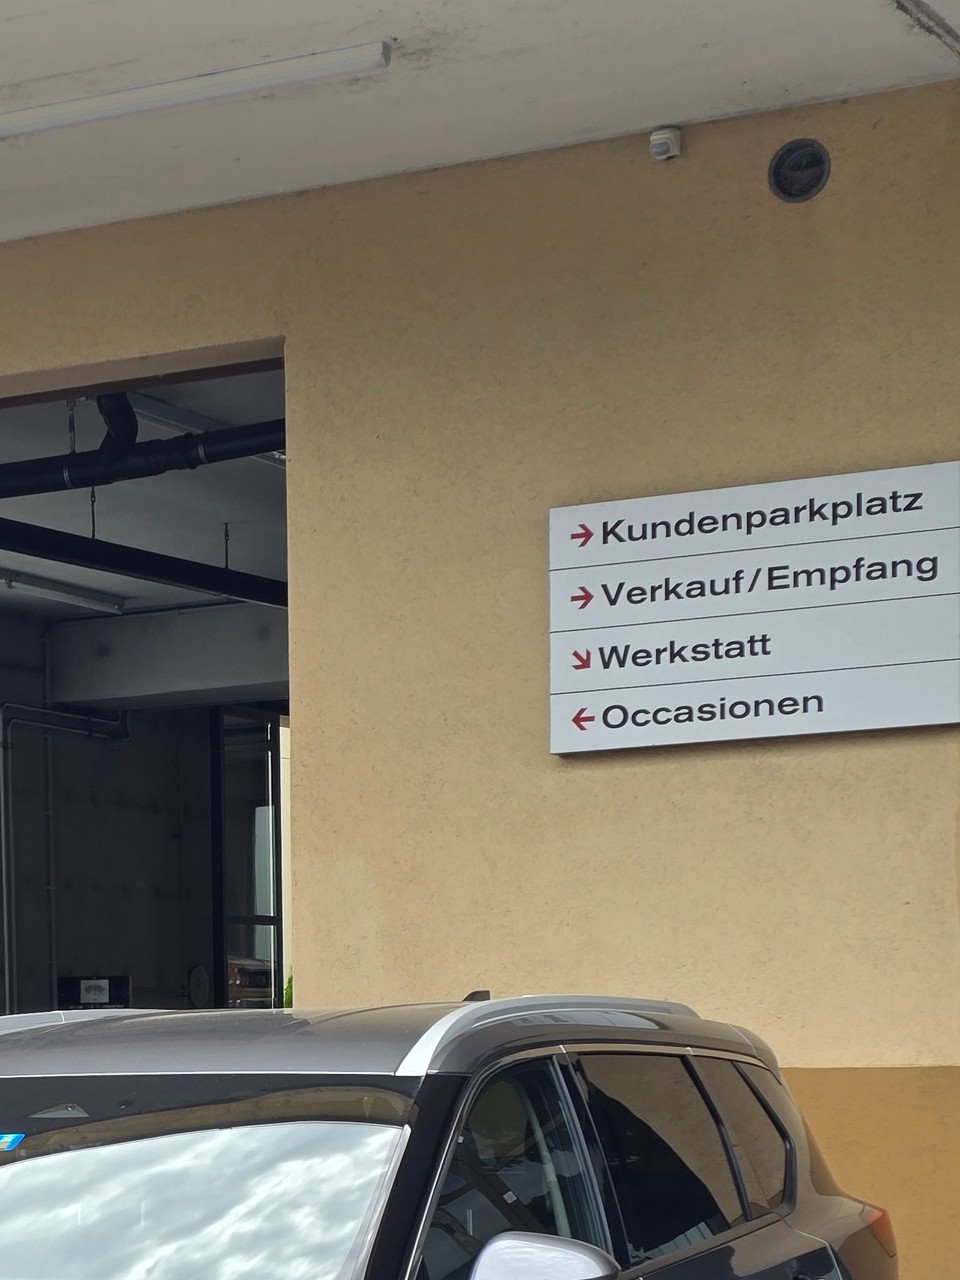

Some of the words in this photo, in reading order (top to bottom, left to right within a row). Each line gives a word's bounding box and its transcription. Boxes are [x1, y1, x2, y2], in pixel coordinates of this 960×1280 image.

[601, 490, 924, 545] Kundenparkplatz
[601, 554, 939, 606] Verkauf/Empfang
[598, 633, 771, 669] Werkstatt
[602, 694, 824, 729] Occasionen
